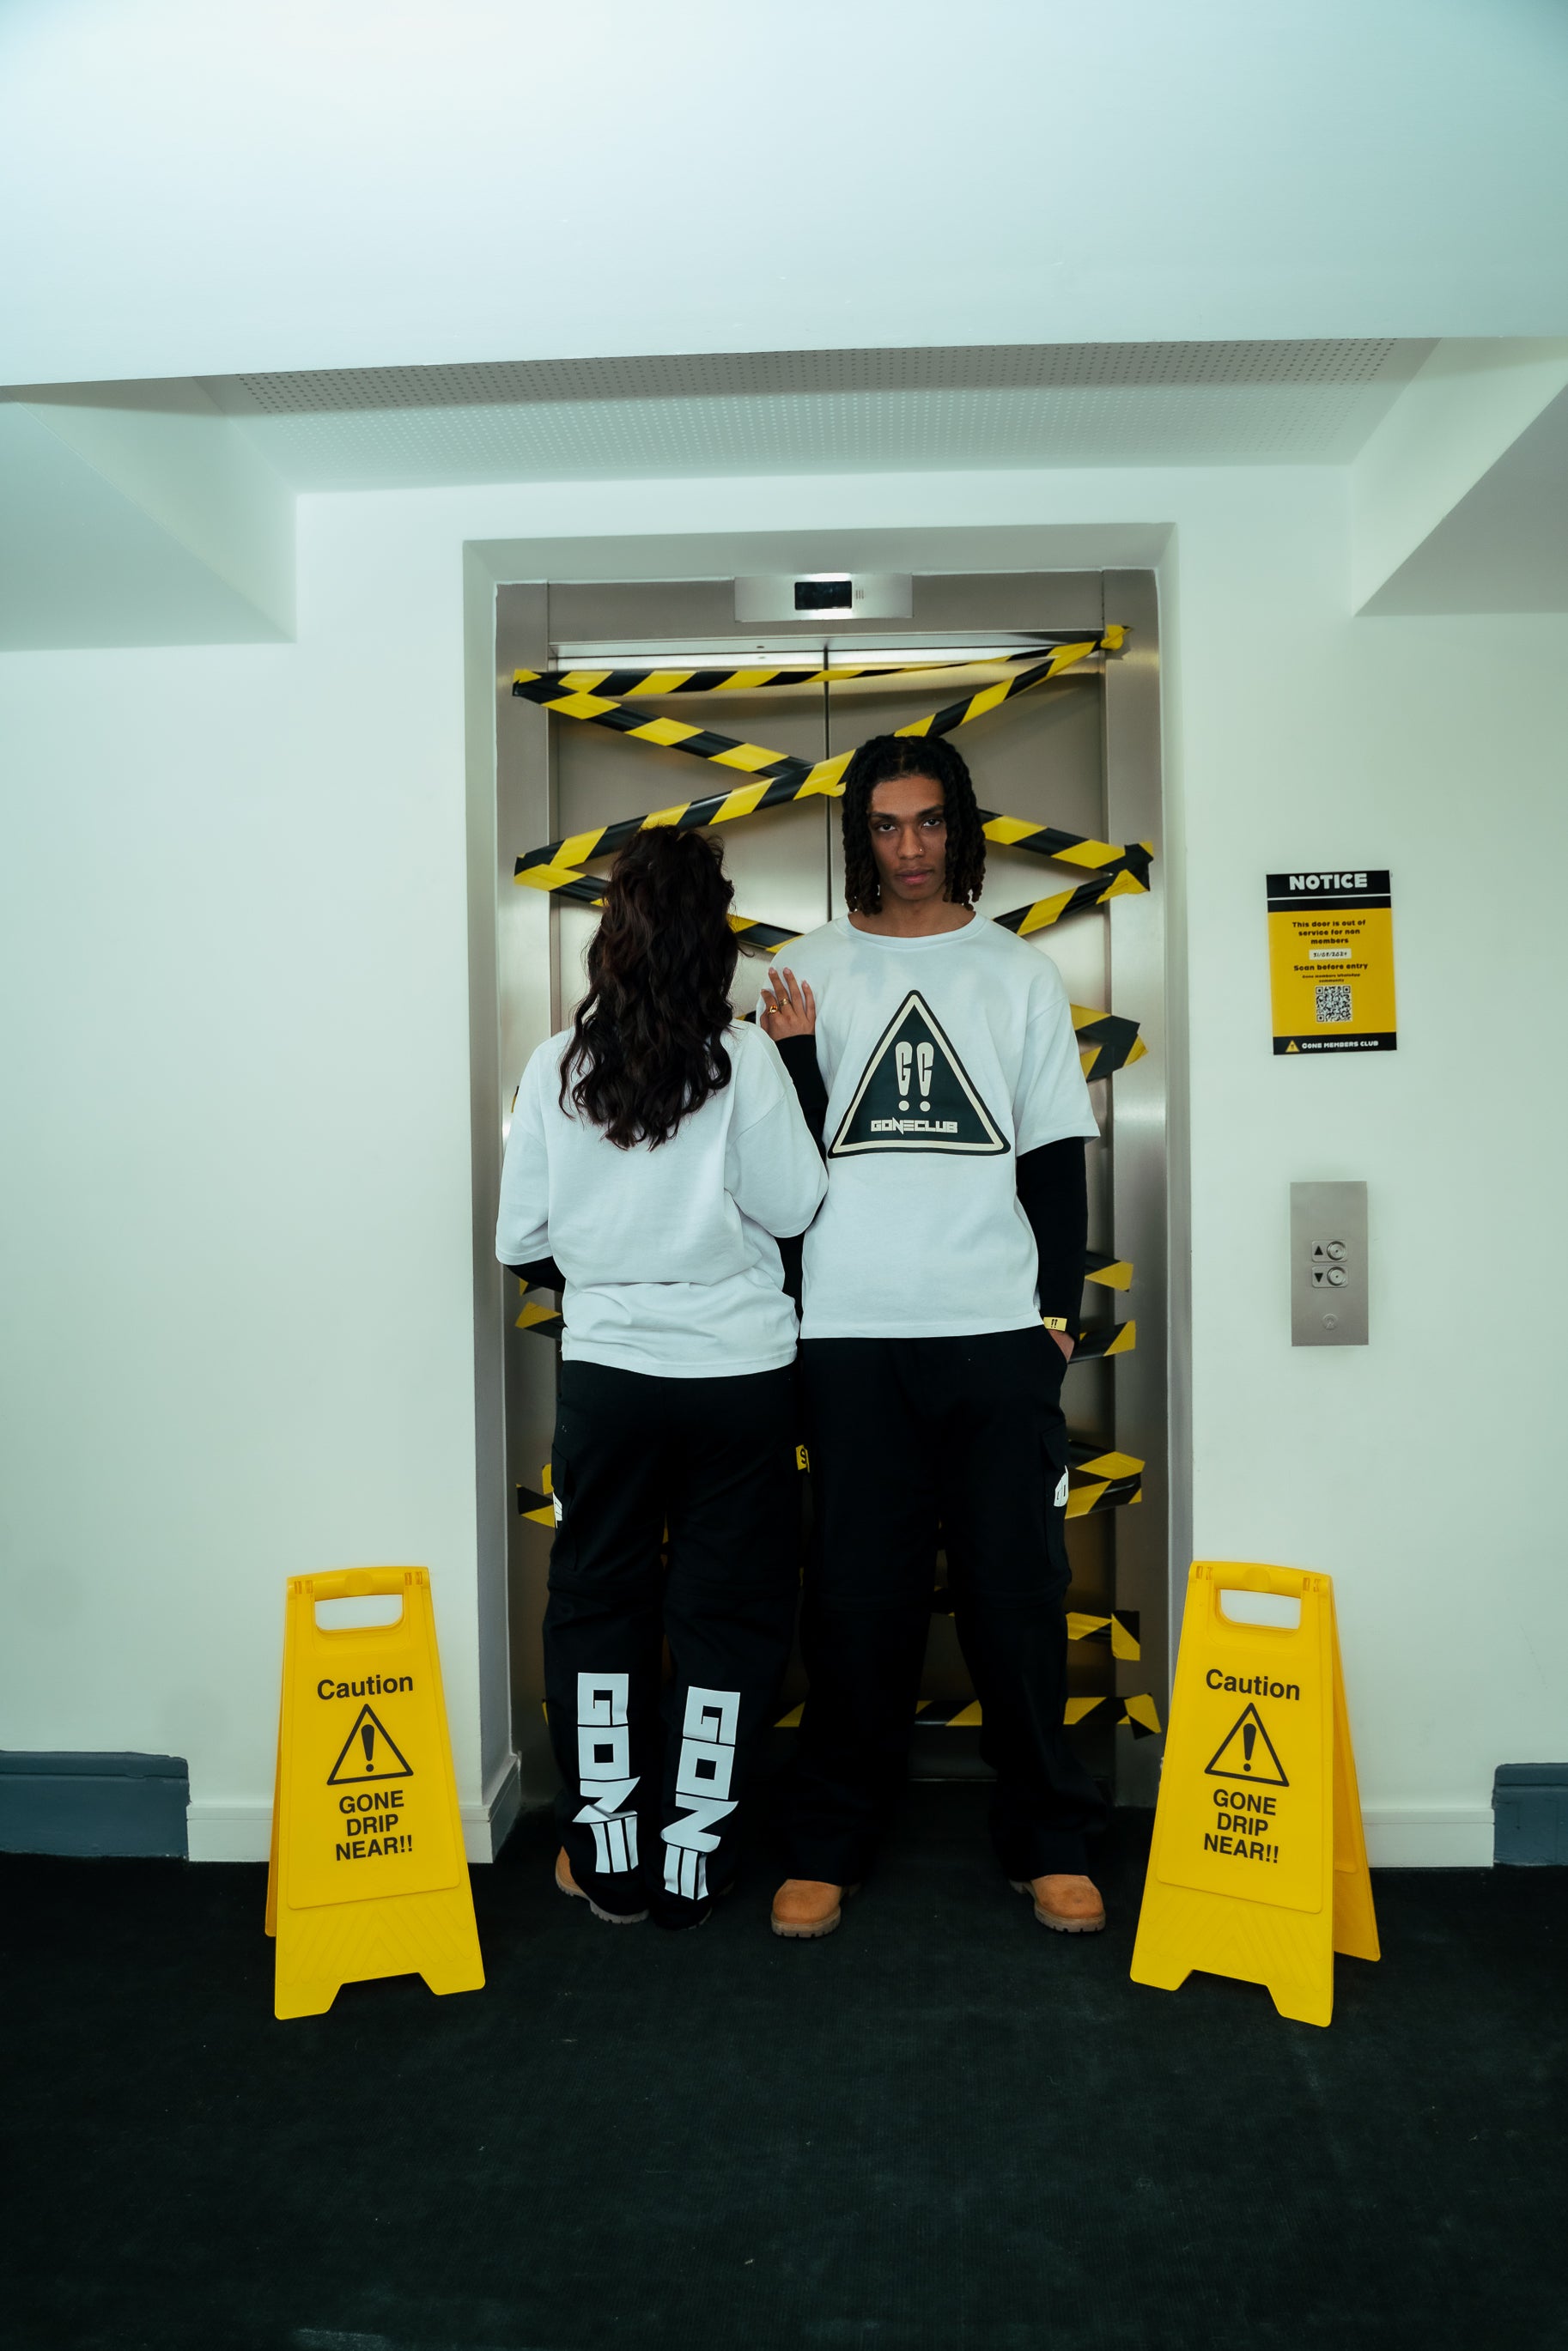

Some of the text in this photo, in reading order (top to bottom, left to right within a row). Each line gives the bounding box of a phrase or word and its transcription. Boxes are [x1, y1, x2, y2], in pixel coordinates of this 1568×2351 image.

[1289, 873, 1368, 890] NOTICE
[871, 1117, 958, 1135] GONECLUB
[317, 1674, 414, 1701] Caution
[1206, 1668, 1300, 1701] Caution
[338, 1789, 404, 1814] GONE
[659, 1686, 741, 1901] GONE
[1212, 1789, 1277, 1817] GONE
[346, 1813, 398, 1838] DRIP
[1217, 1812, 1268, 1838] DRIP
[335, 1835, 413, 1862] NEAR!!
[1203, 1833, 1279, 1864] NEAR!!
